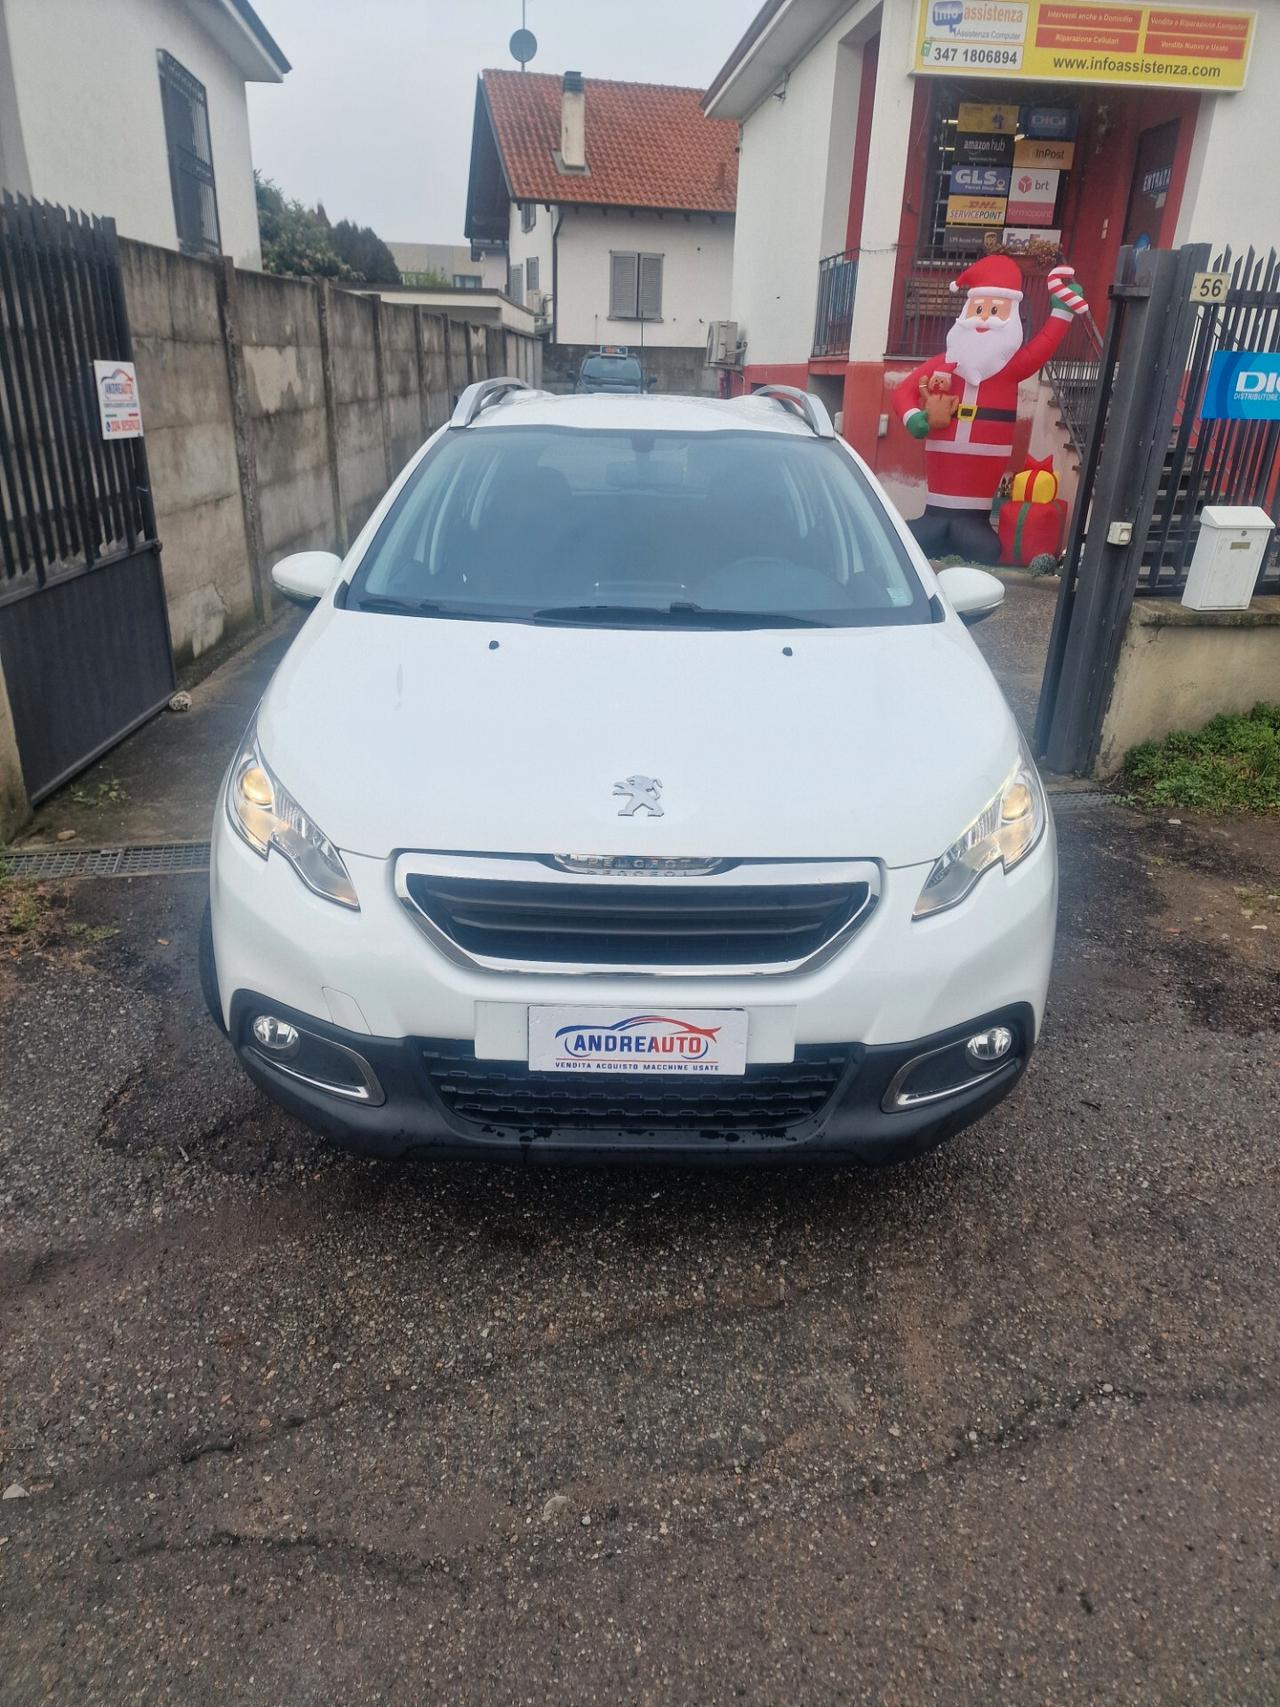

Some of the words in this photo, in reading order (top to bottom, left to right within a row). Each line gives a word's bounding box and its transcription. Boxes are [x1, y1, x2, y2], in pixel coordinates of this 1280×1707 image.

[1150, 17, 1173, 25] Vendita
[1160, 41, 1183, 49] Vendita
[934, 47, 958, 61] 347
[962, 48, 1018, 64] 1806894
[1053, 56, 1221, 78] www.infoassistenza.com
[963, 140, 990, 151] amazon
[990, 139, 1006, 152] hub
[1035, 148, 1065, 160] InPost
[955, 169, 997, 185] GLS
[1034, 178, 1050, 191] brt
[968, 200, 998, 209] DHL
[1200, 278, 1223, 297] 56
[1236, 371, 1280, 393] DI
[573, 1034, 701, 1054] ANDREAUTO
